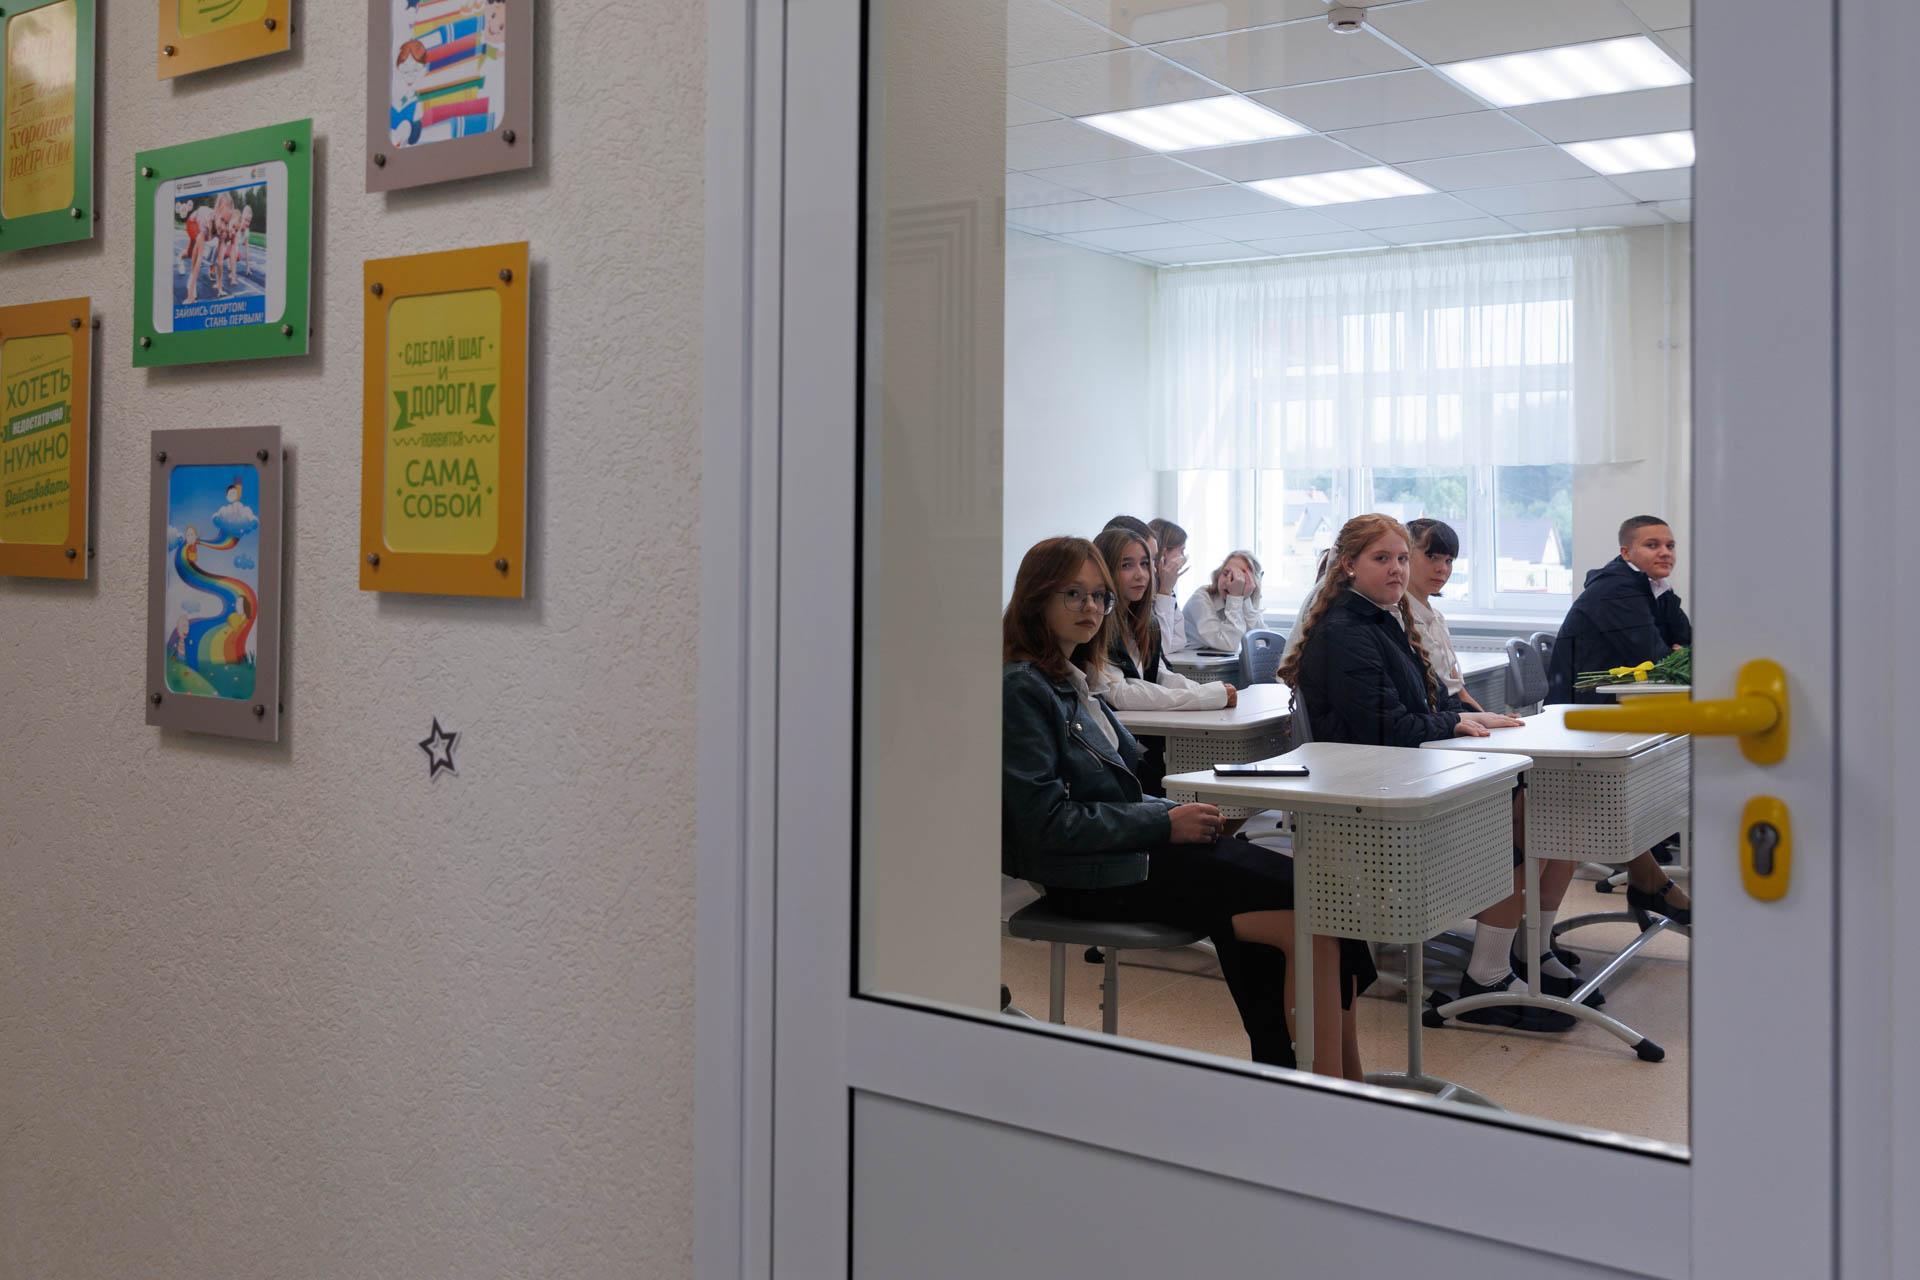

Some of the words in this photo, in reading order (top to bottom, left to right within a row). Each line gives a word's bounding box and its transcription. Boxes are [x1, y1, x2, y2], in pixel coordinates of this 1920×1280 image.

[175, 305, 208, 319] ЗАЙМИСЬ
[209, 301, 247, 315] СПОРТОМ!
[204, 316, 228, 328] СТАНЬ
[229, 312, 264, 325] ПЕРВЫМ!
[404, 335, 455, 366] СДЕЛАЙ
[458, 336, 485, 361] ШАГ
[438, 366, 448, 381] И
[6, 368, 71, 411] ХОТЕТЬ
[410, 381, 477, 420] ДОРОГА
[12, 407, 64, 435] НЕДОСТАТОЧНО
[3, 432, 69, 475] НУЖНО
[405, 458, 481, 487] САМА
[403, 486, 482, 518] СОБОЙ
